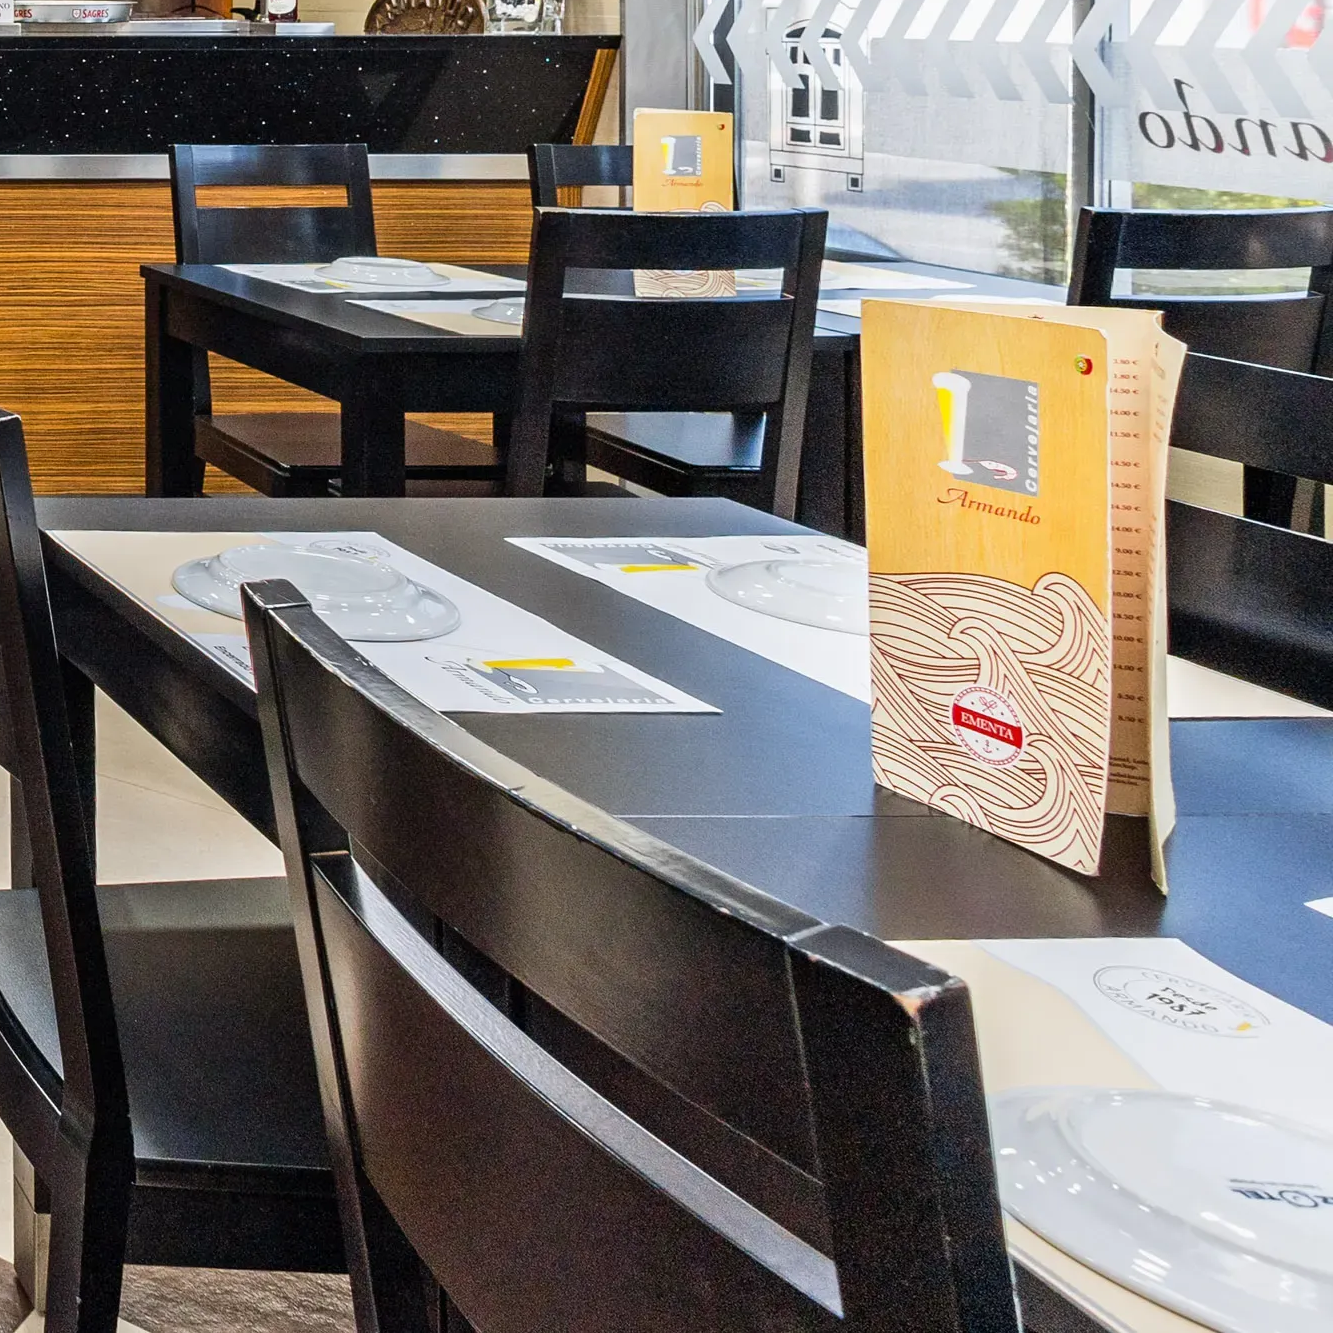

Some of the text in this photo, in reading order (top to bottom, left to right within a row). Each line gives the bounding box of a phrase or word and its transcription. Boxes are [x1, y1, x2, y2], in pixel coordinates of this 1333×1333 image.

[14, 9, 33, 18] GRES
[82, 8, 109, 18] SAGRES
[1025, 384, 1039, 494] Cervejaria
[937, 486, 1042, 526] Armando
[528, 697, 671, 705] Cervejaria
[960, 710, 1014, 741] EMENTA
[1100, 983, 1220, 1034] ARMANDO
[1146, 992, 1207, 1017] 1987
